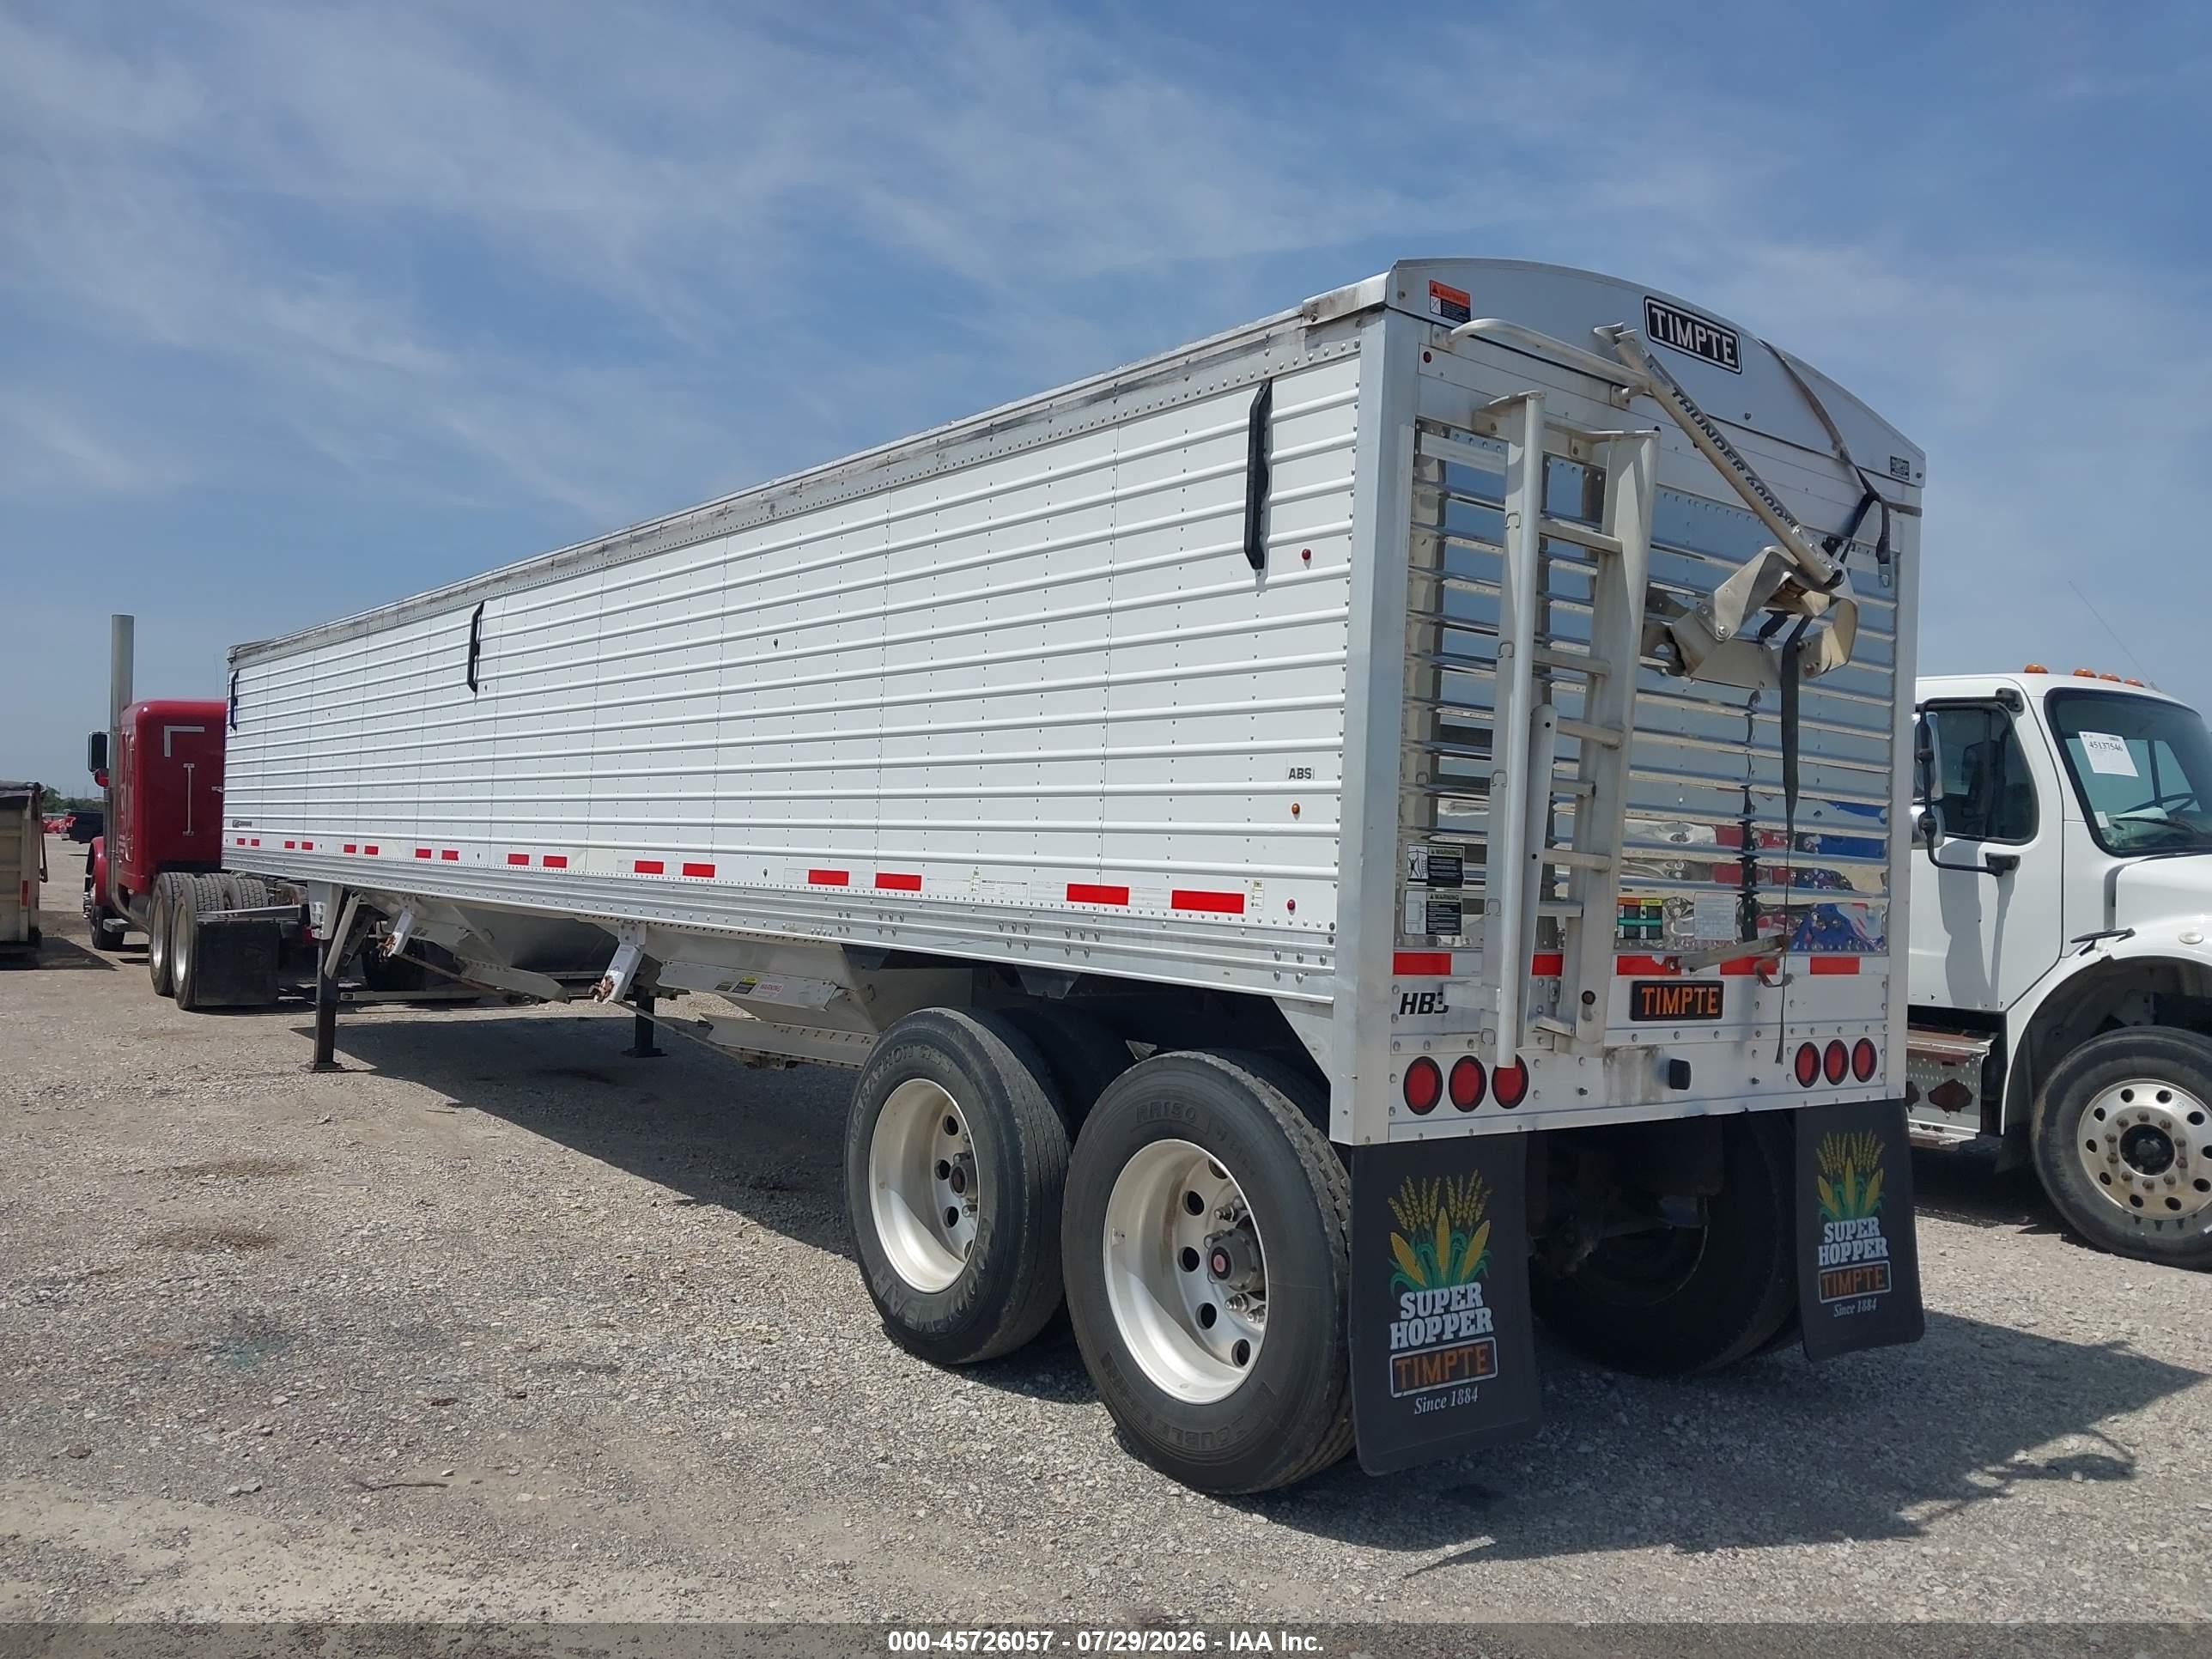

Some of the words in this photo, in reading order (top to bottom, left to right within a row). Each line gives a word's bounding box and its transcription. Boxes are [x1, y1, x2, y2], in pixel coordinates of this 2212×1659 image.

[1651, 307, 1735, 365] TIMPTE
[1672, 386, 1746, 472] THUNDER
[1288, 767, 1312, 780] ABS
[1642, 988, 1719, 1015] TIMPTE
[1824, 1217, 1881, 1243] SUPER
[1818, 1237, 1888, 1267] HOPPER
[1821, 1266, 1885, 1297] TIMPTE
[1401, 1282, 1484, 1320] SUPER
[1833, 1303, 1855, 1318] Since
[1857, 1297, 1877, 1313] 1884
[1389, 1307, 1494, 1351] HOPPER
[1395, 1344, 1489, 1389] TIMPTE
[1414, 1395, 1447, 1415] Since
[1451, 1386, 1479, 1407] 1884
